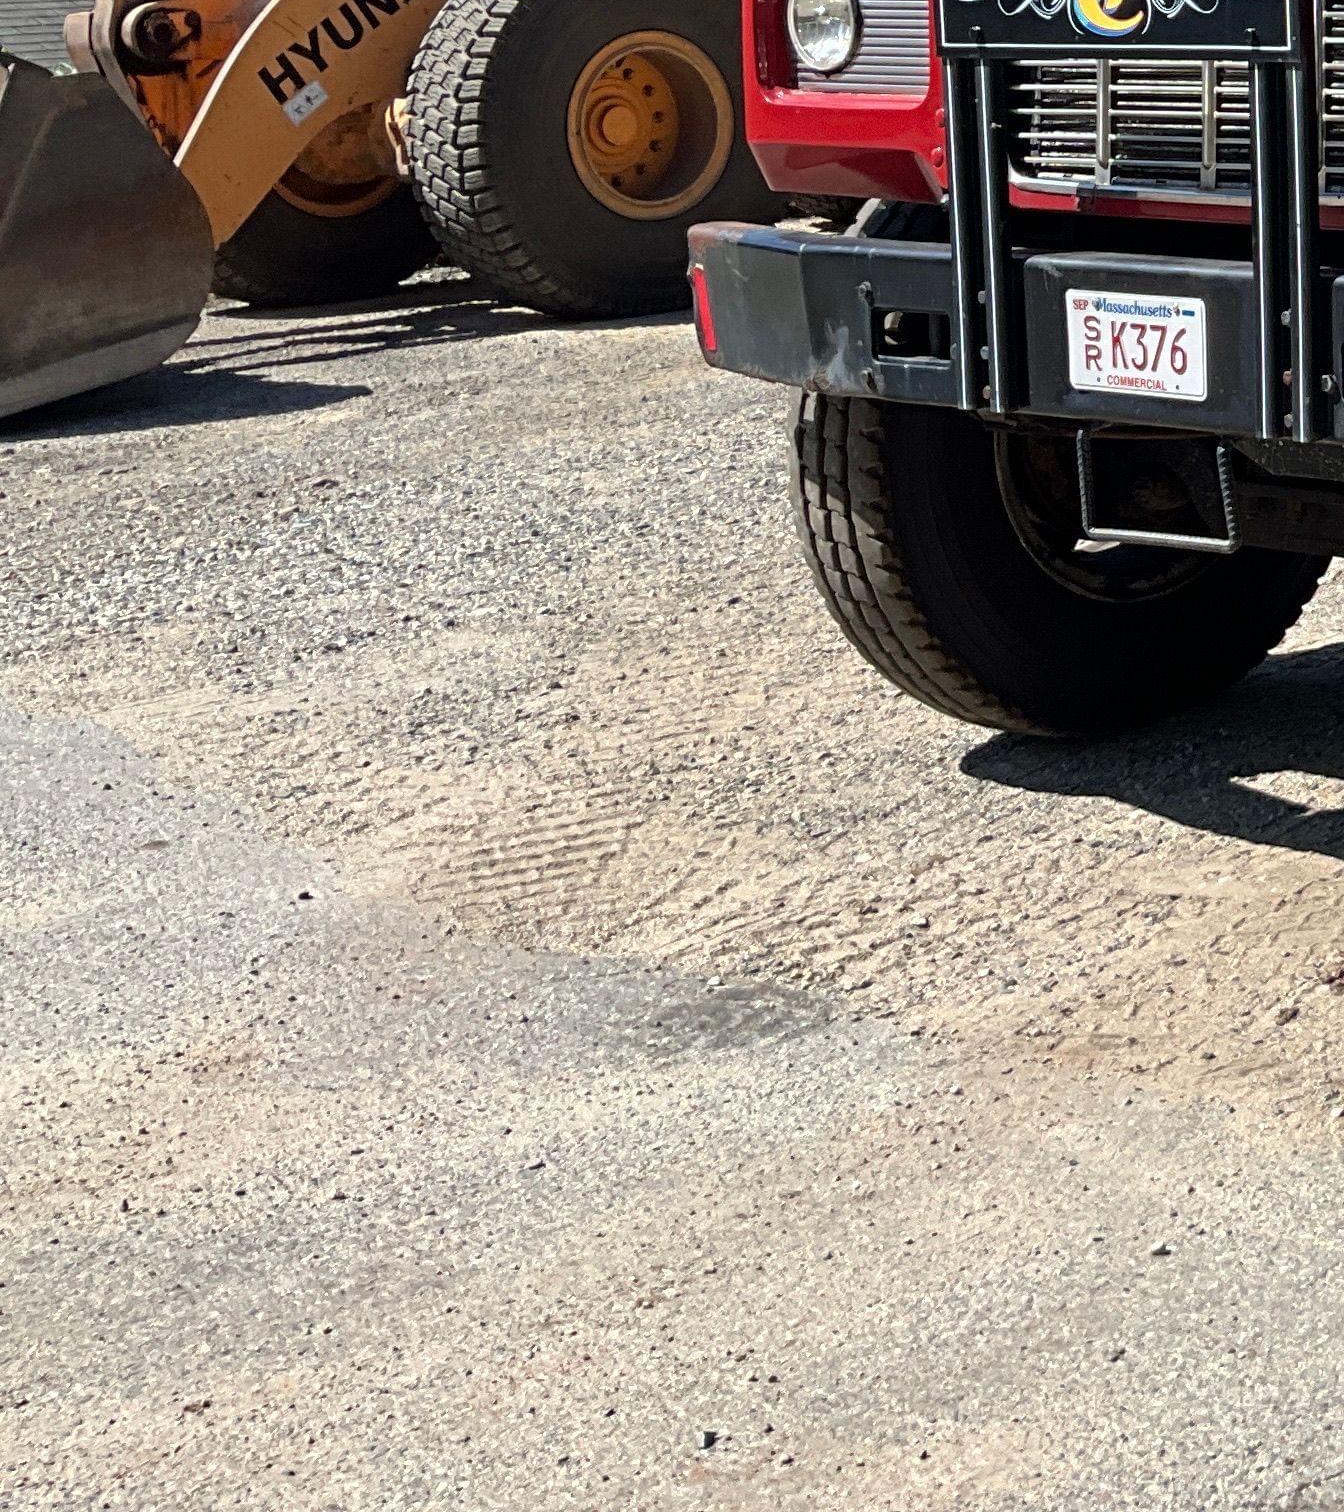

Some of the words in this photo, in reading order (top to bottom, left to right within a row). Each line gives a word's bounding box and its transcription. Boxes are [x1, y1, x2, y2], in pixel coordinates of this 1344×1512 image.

[1072, 298, 1089, 311] SEP
[1110, 320, 1188, 376] K376
[1106, 374, 1168, 392] COMMERCIAL
